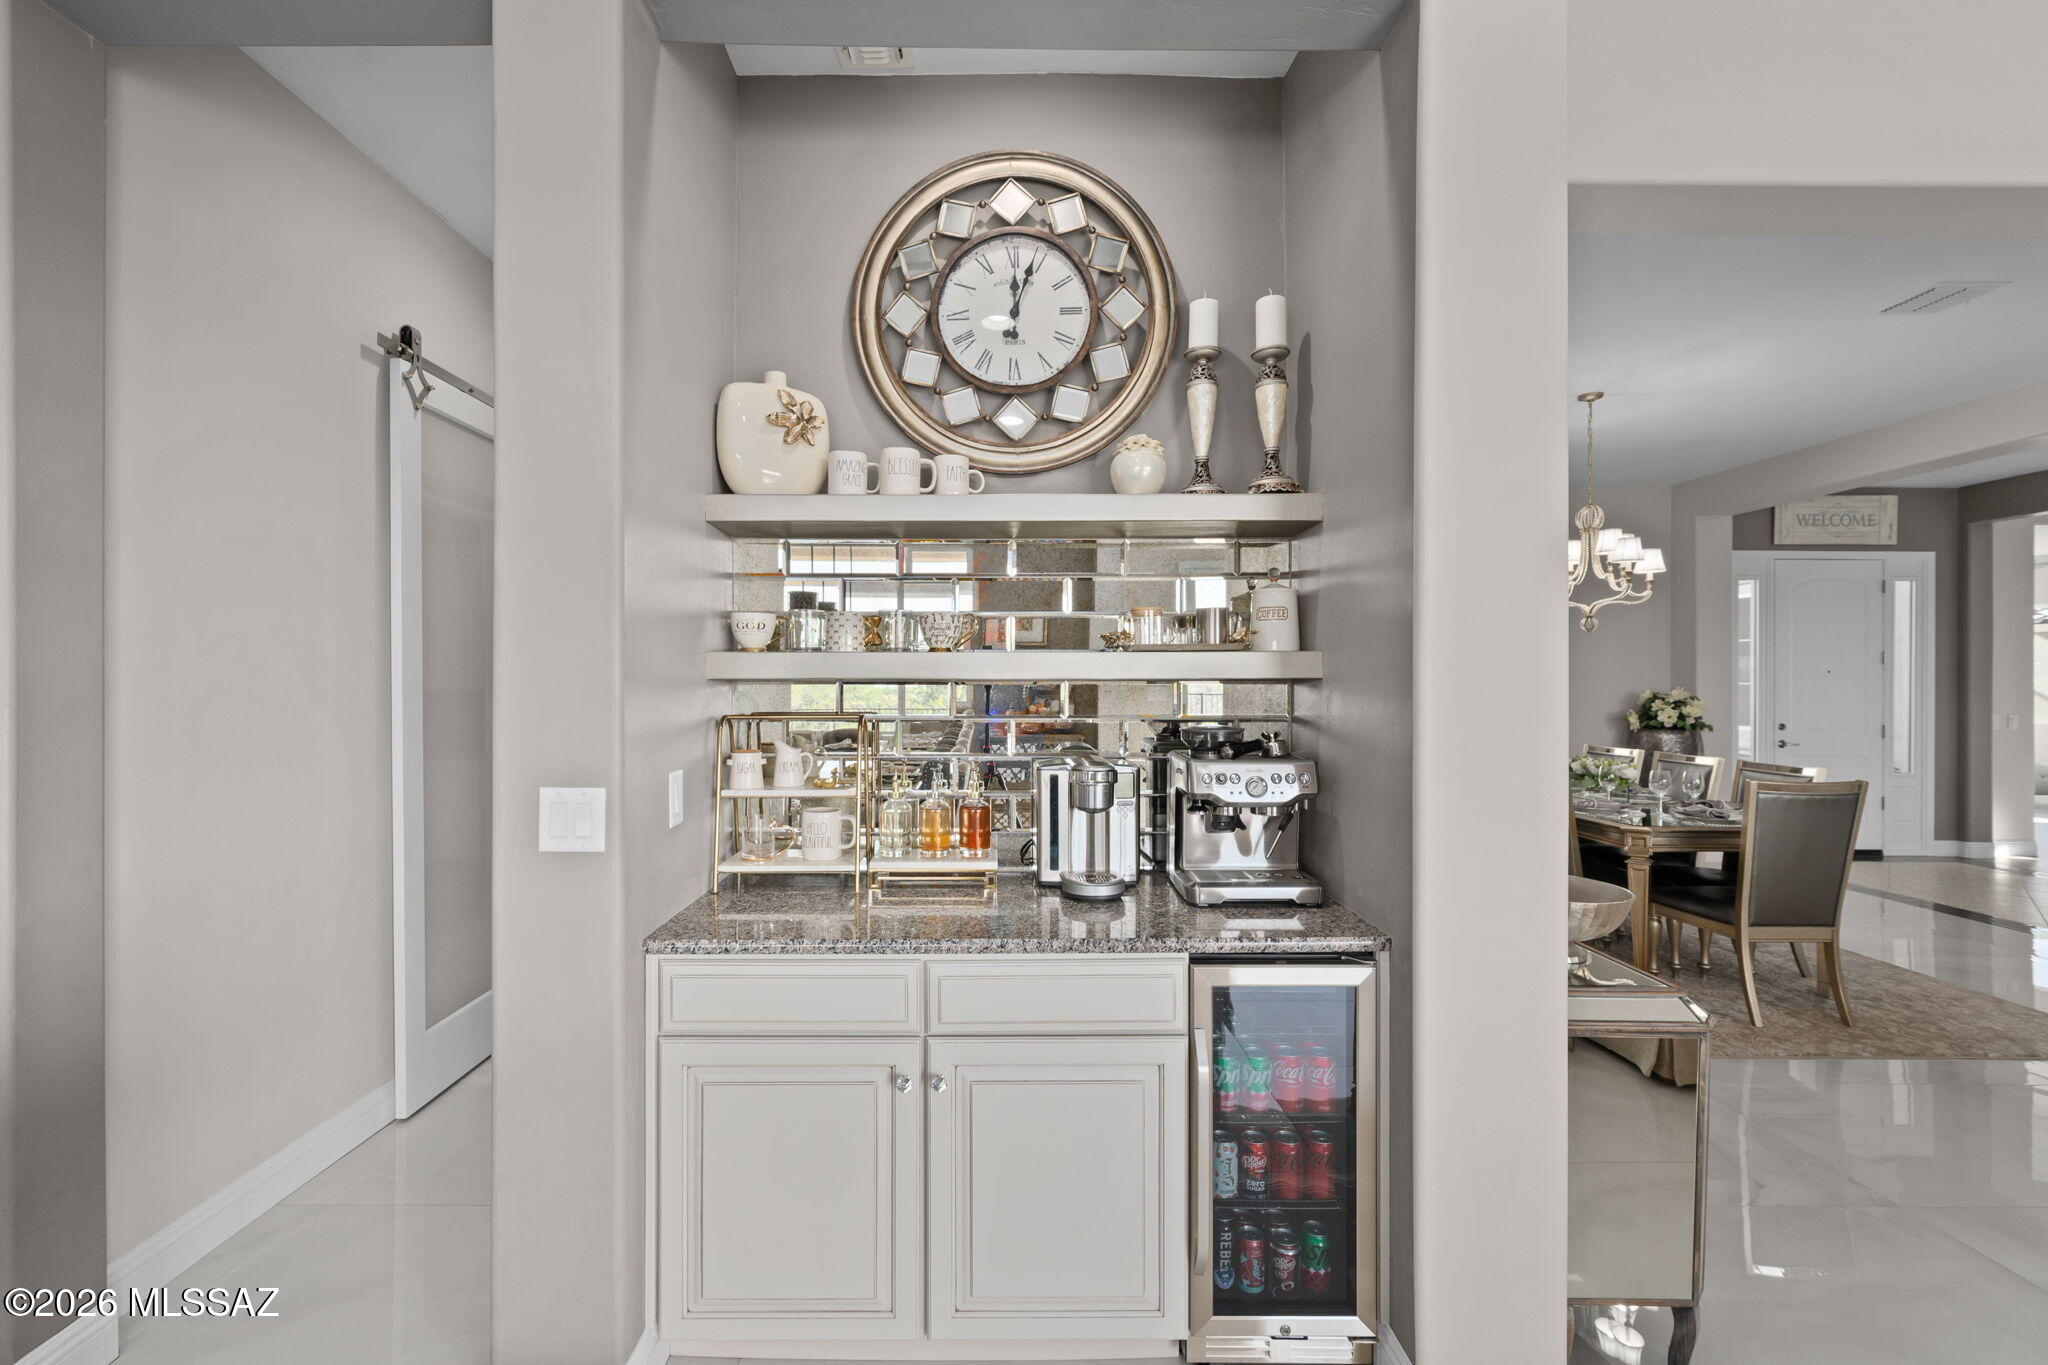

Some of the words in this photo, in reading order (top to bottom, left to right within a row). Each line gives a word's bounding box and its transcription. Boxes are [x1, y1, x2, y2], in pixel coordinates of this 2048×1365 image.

[842, 472, 861, 486] GRACE
[946, 465, 966, 481] FAITH
[1796, 513, 1877, 527] WELCOME
[1257, 608, 1287, 619] COFFEE
[736, 621, 766, 630] GOD
[736, 761, 757, 775] SUGAR
[779, 760, 800, 773] CREAM
